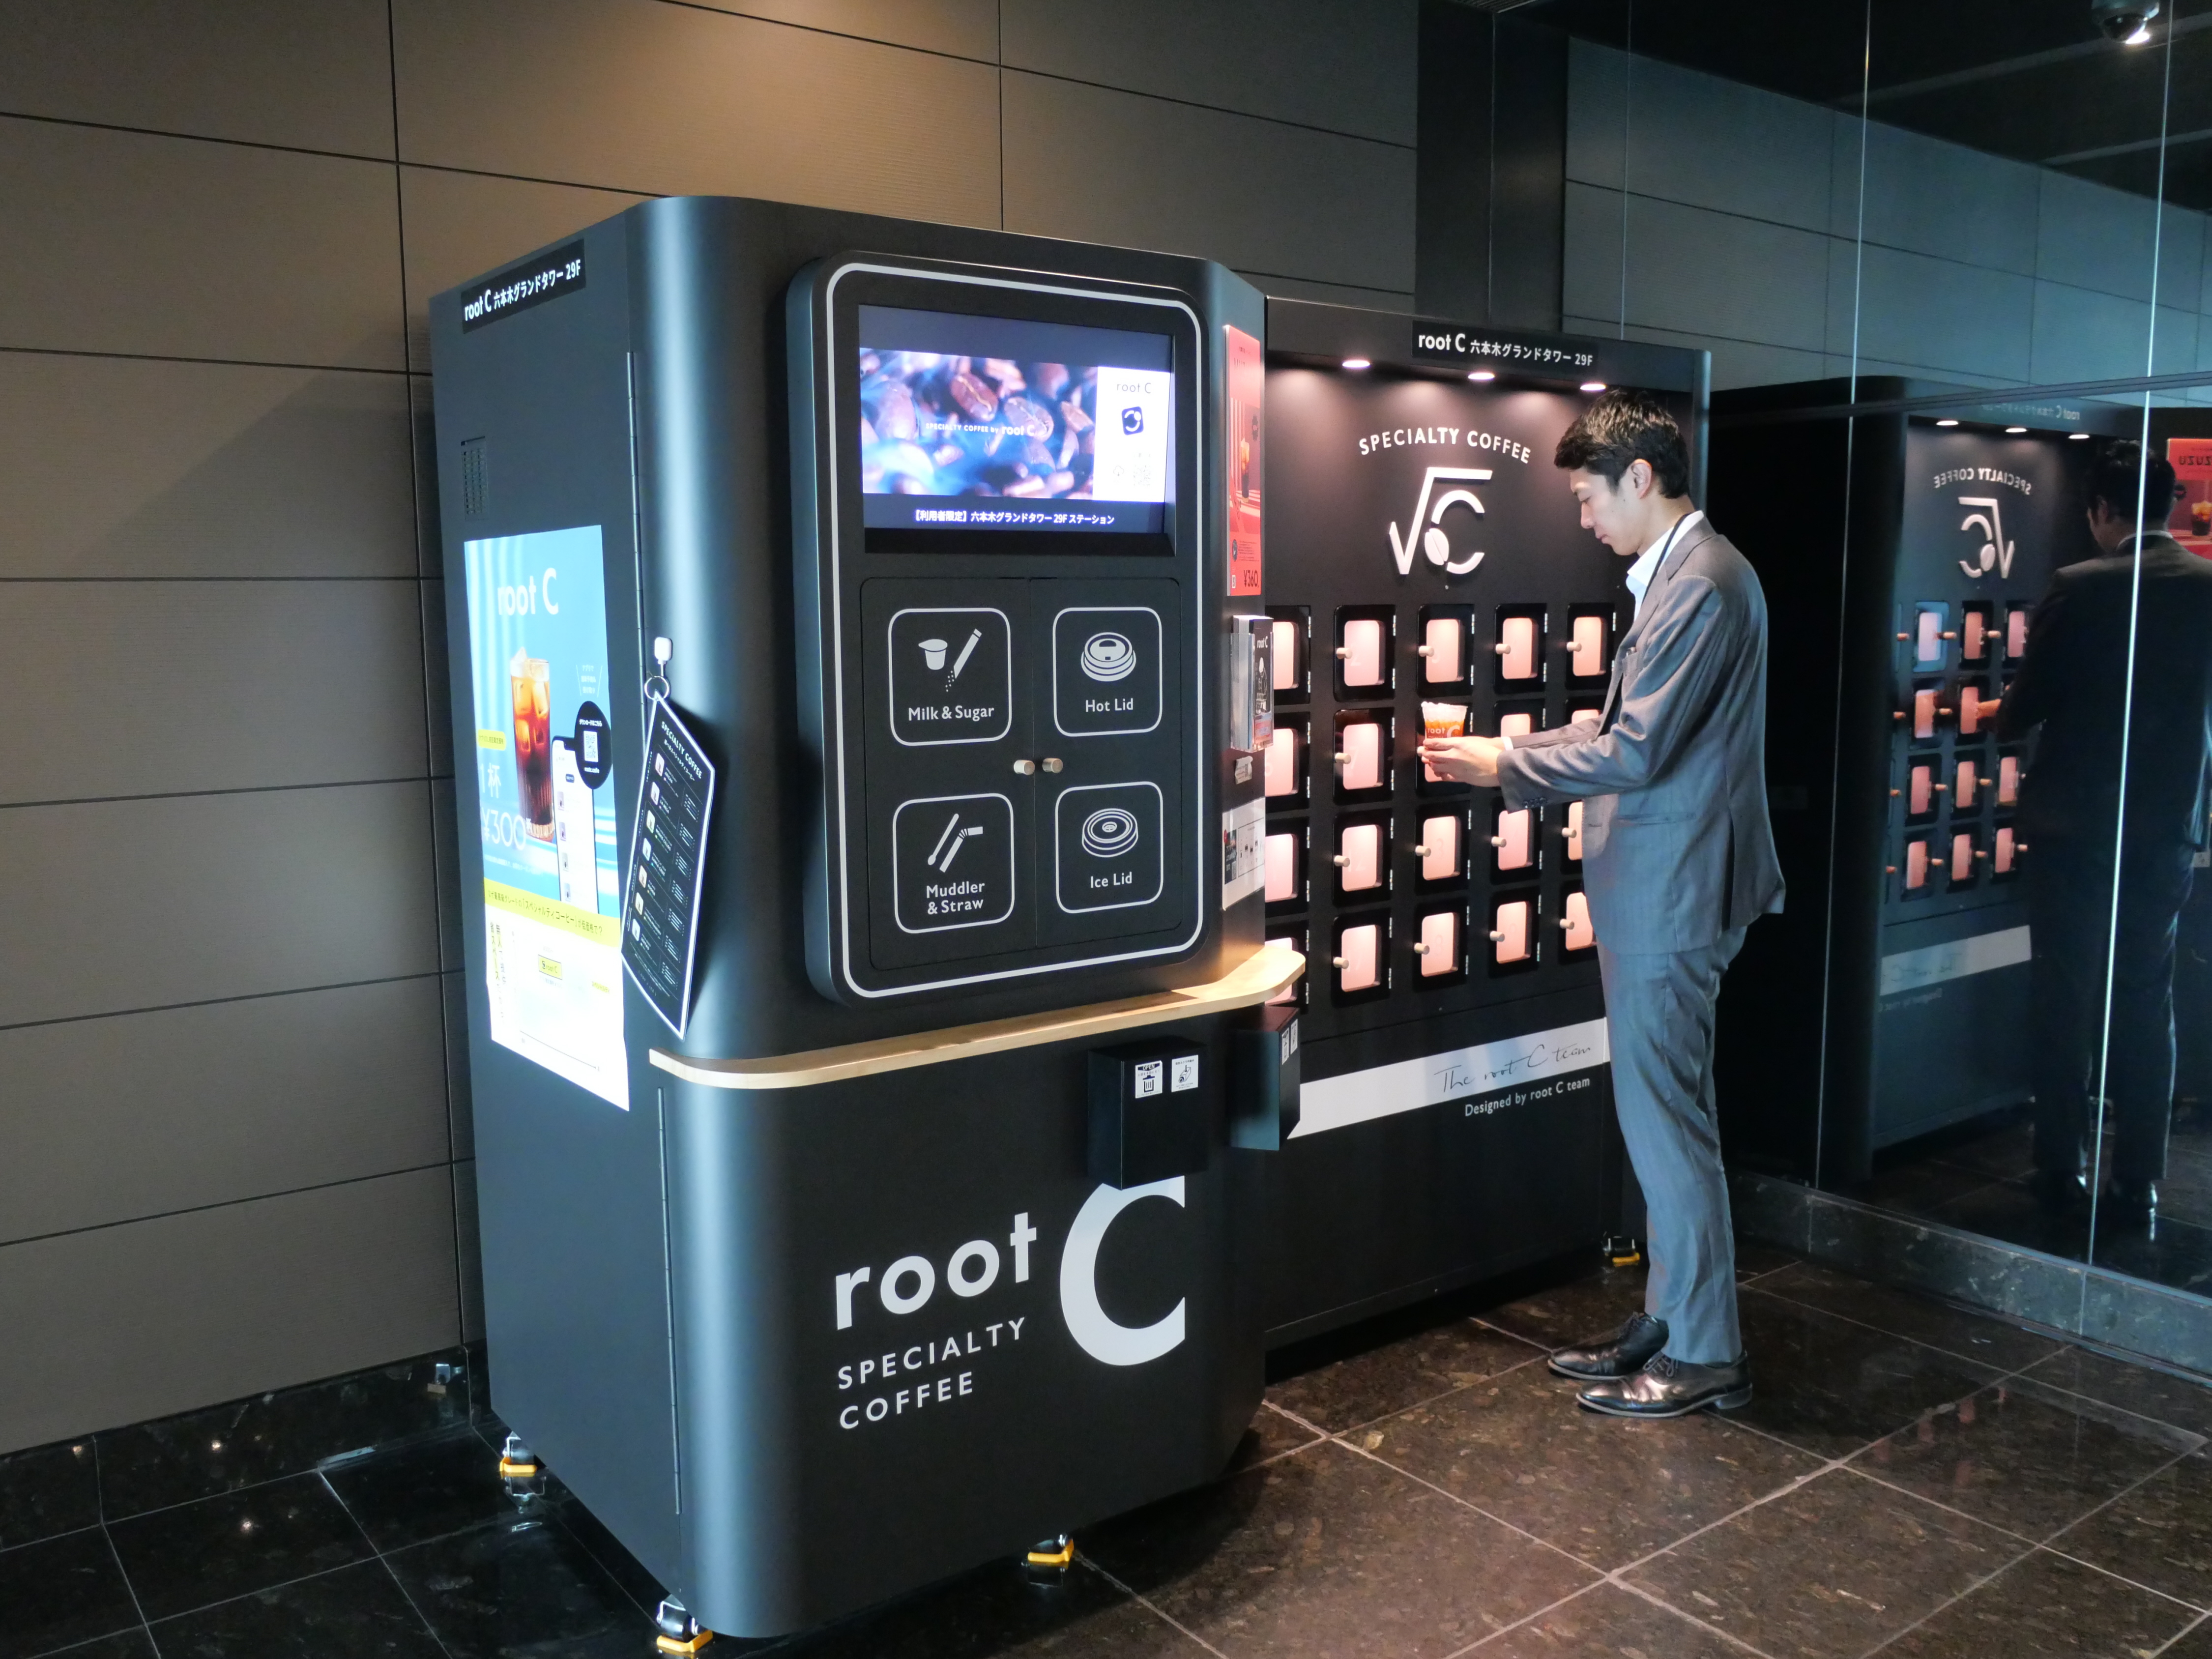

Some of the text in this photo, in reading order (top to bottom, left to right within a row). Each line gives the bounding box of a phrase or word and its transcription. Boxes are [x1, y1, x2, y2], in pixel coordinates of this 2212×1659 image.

[465, 259, 581, 321] root C 六本木グランドタワー 29F
[1419, 334, 1593, 366] root C 六本木グランドタワー 29F
[1117, 382, 1151, 393] root C
[926, 423, 961, 431] SPECIALTY
[1002, 425, 1024, 436] root
[1027, 424, 1035, 436] C
[1359, 427, 1531, 464] SPECIALTY COFFEE
[915, 509, 1114, 524] 【利用者限定】 六本木グランドタワー 29F ステーション
[1243, 569, 1258, 587] ¥360
[498, 568, 558, 615] root C
[1256, 639, 1265, 649] root
[908, 705, 994, 721] Milk & Sugar
[1085, 698, 1134, 712] Hot Lid
[661, 721, 685, 755] SPECIALTY
[685, 753, 702, 779] COFFEE
[927, 881, 985, 898] Muddler
[1090, 872, 1133, 888] Ice Lid
[928, 899, 984, 914] & Straw
[1434, 1065, 1476, 1093] The
[1484, 1056, 1529, 1080] root
[1552, 1043, 1591, 1062] team
[1465, 1077, 1590, 1117] Designed by root C team
[836, 1175, 1185, 1366] root C
[838, 1317, 1024, 1389] SPECIALTY
[840, 1371, 972, 1429] COFFEE
